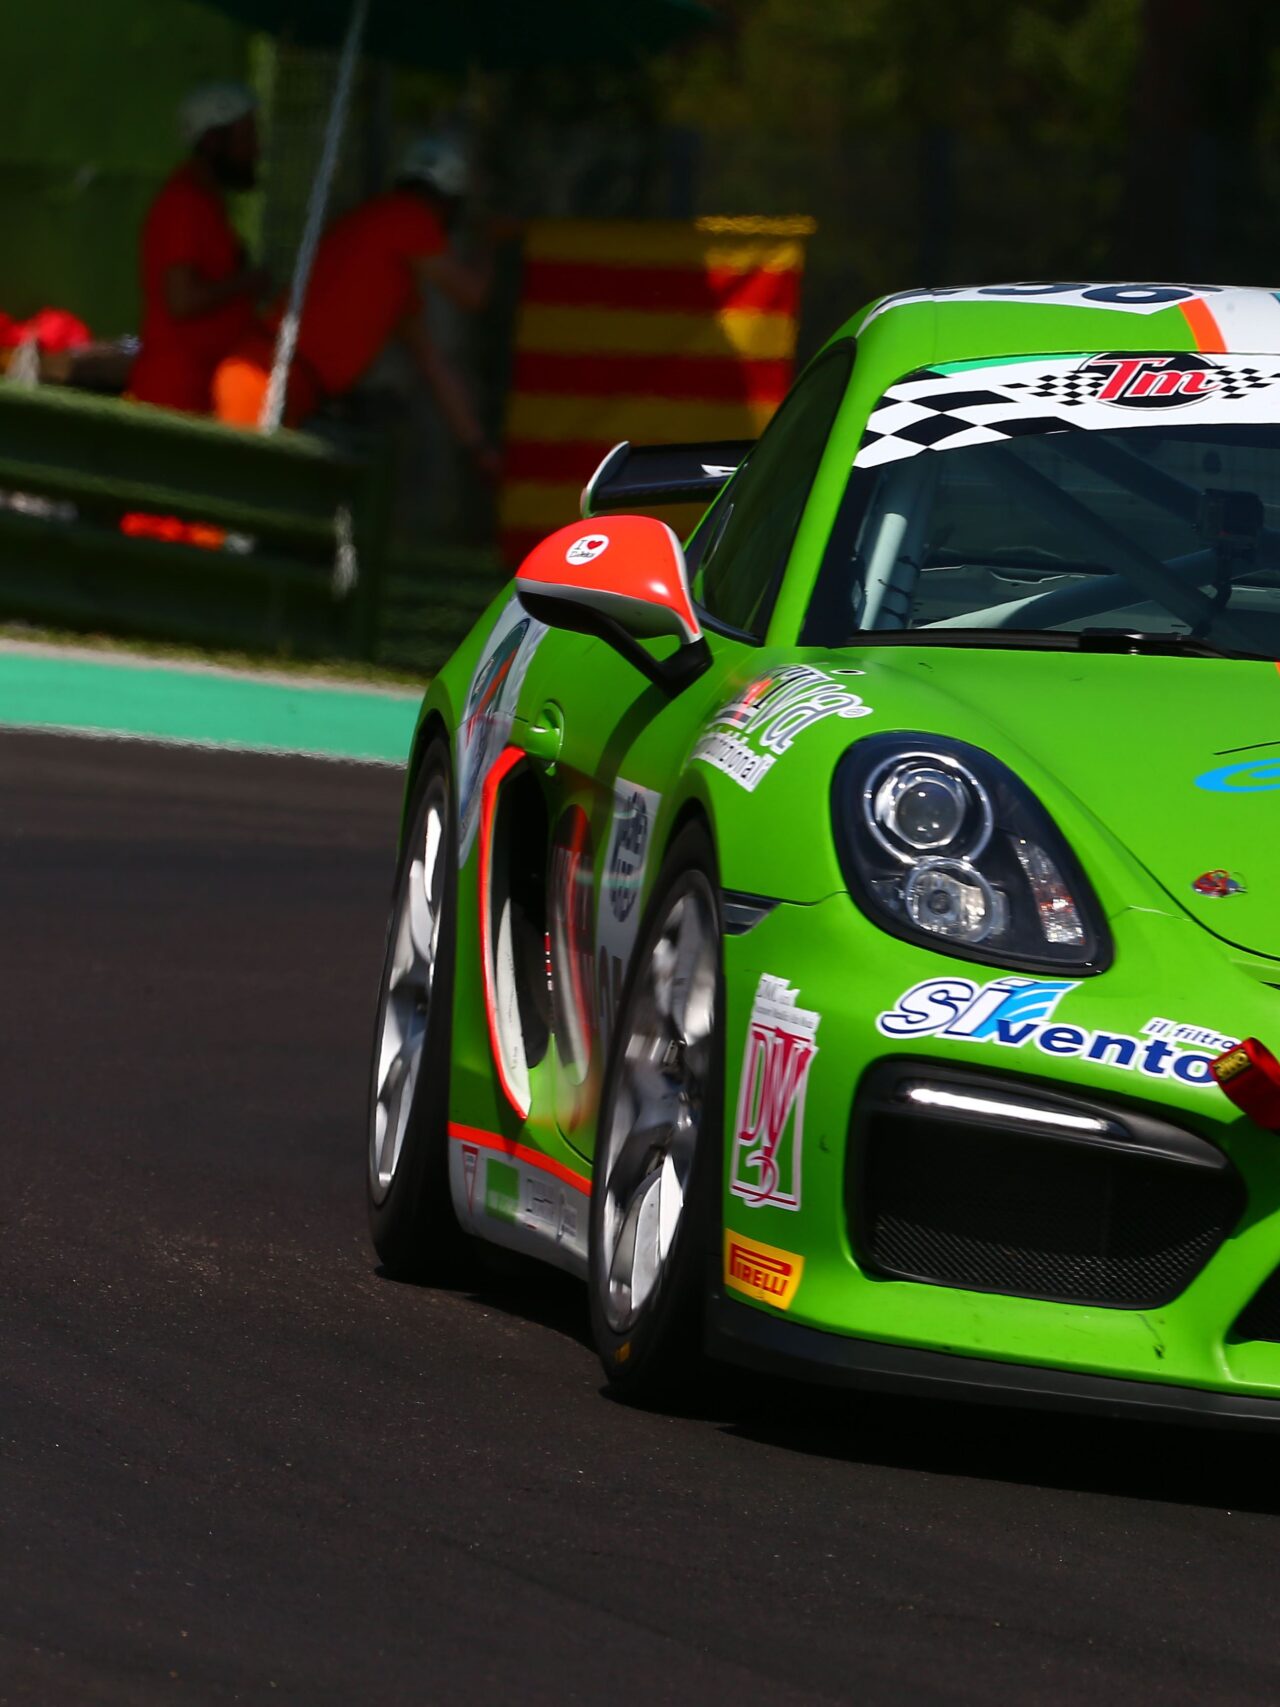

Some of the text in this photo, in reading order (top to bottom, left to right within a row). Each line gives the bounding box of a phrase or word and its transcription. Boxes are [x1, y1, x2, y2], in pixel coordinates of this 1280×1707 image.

[1148, 1019, 1237, 1050] il filtro
[730, 1243, 793, 1297] PIRELLI
